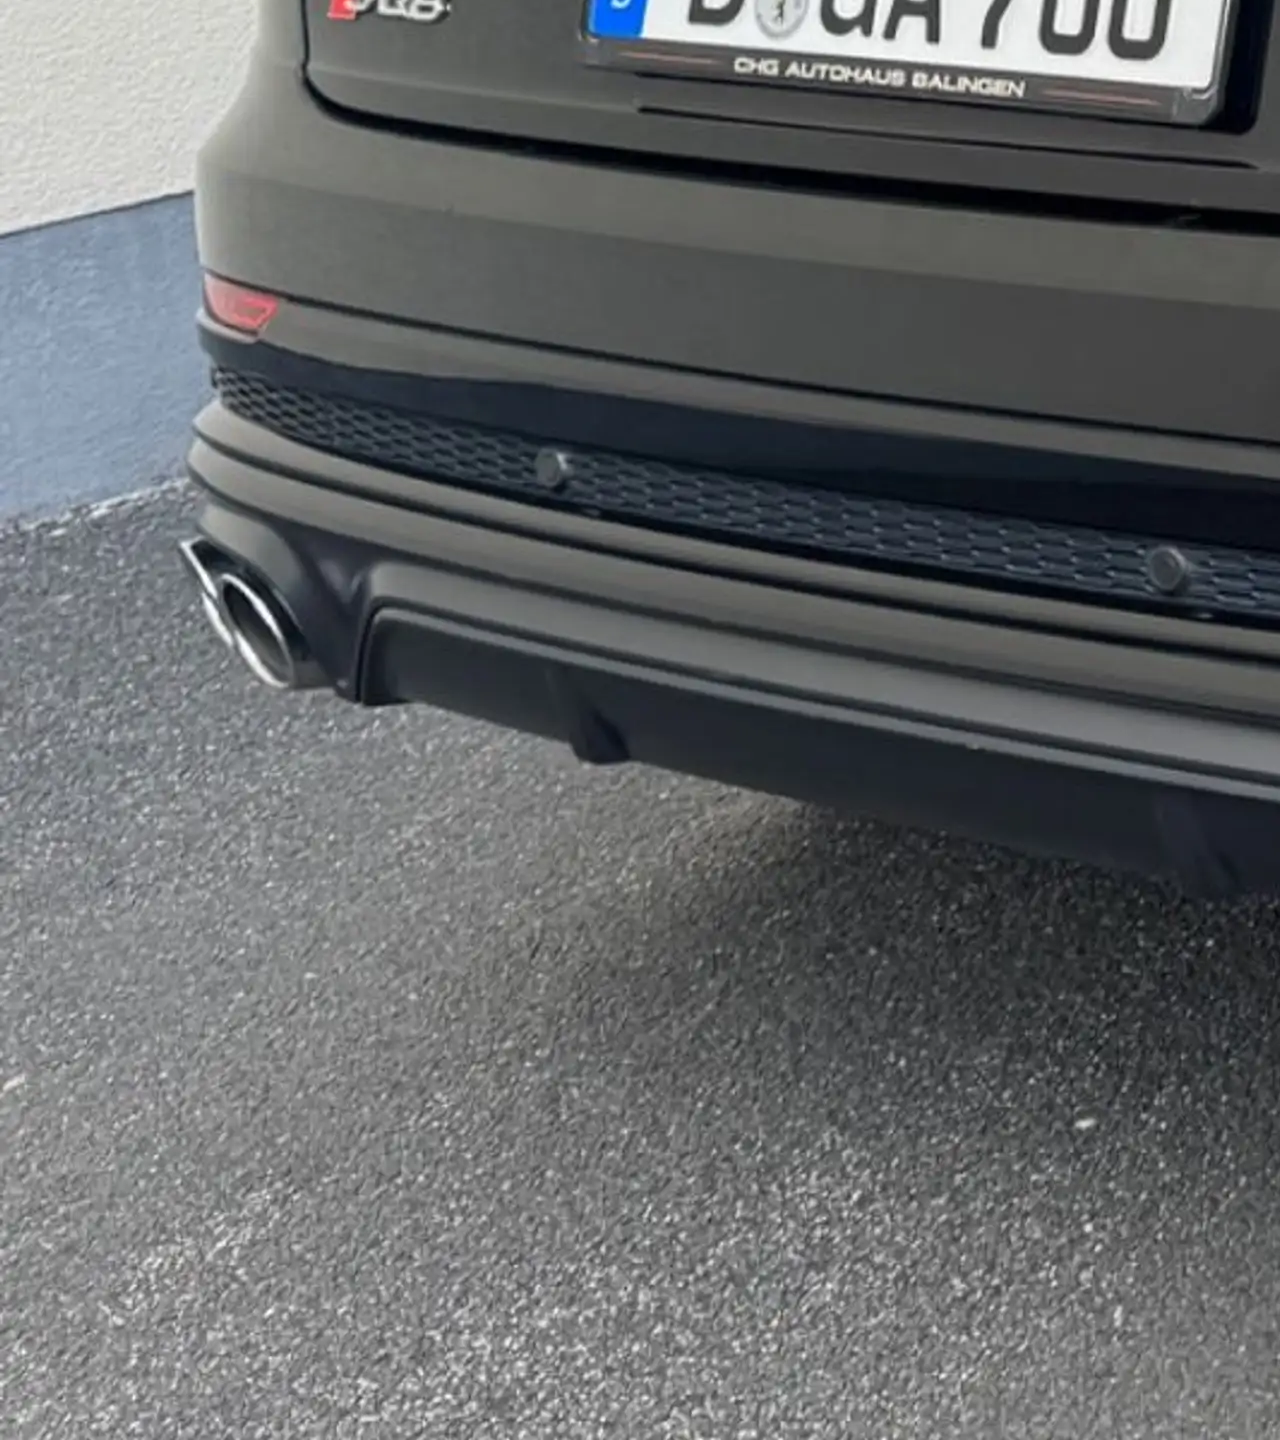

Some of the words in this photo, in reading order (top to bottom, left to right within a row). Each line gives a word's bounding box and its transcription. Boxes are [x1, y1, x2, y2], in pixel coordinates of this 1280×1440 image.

[733, 56, 780, 76] CHG
[784, 61, 906, 87] AUTOHAUS
[911, 71, 1026, 98] BALINGEN
